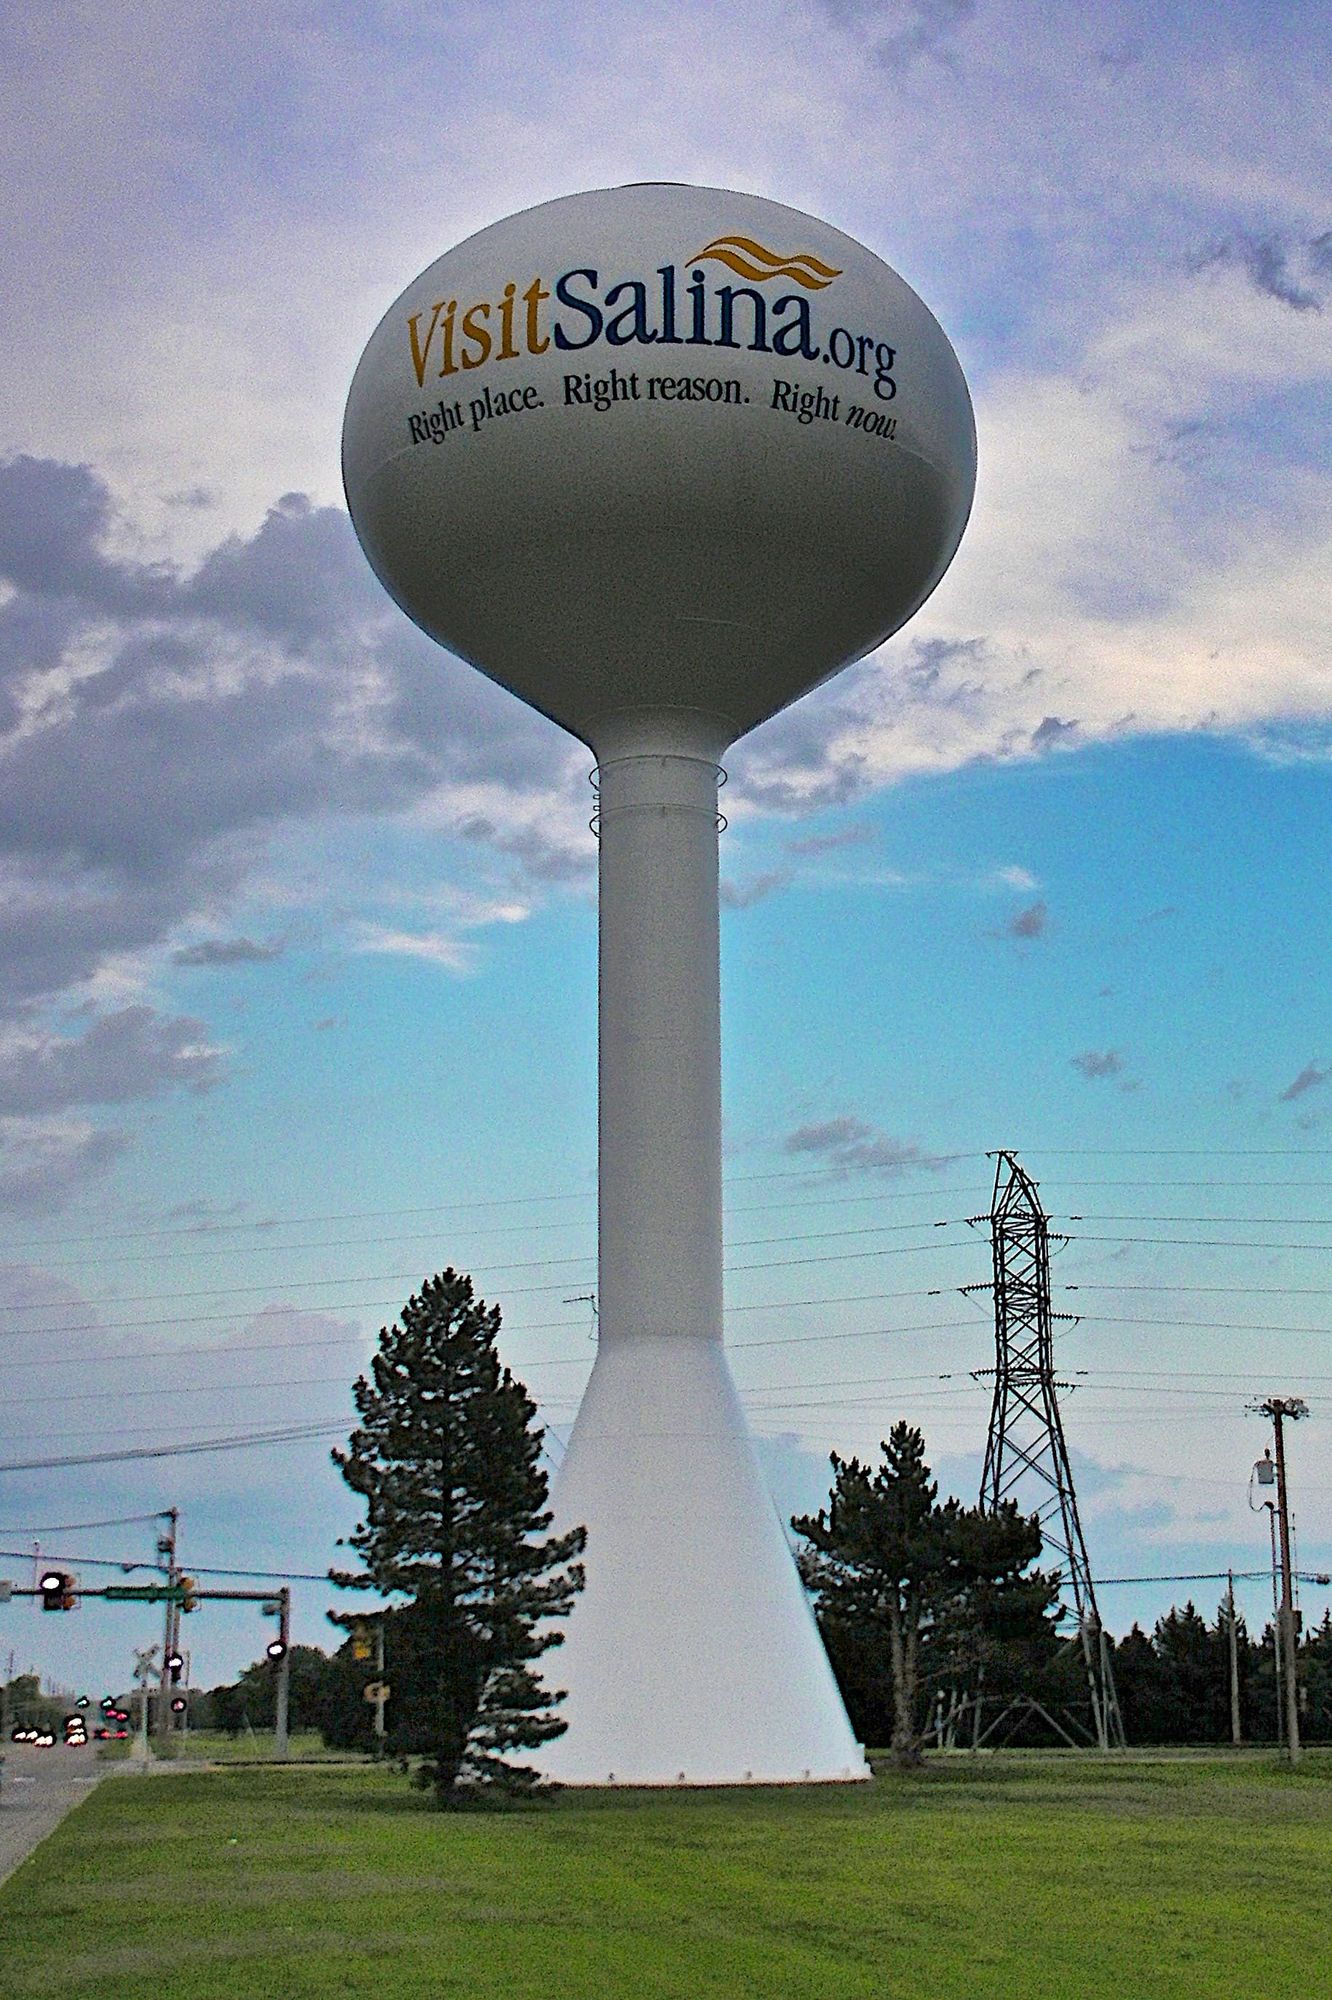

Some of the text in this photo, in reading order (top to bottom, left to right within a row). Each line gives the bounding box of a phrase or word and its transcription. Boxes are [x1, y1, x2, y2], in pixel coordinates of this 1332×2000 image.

[408, 368, 897, 445] Right place. Right reason. Right now.
